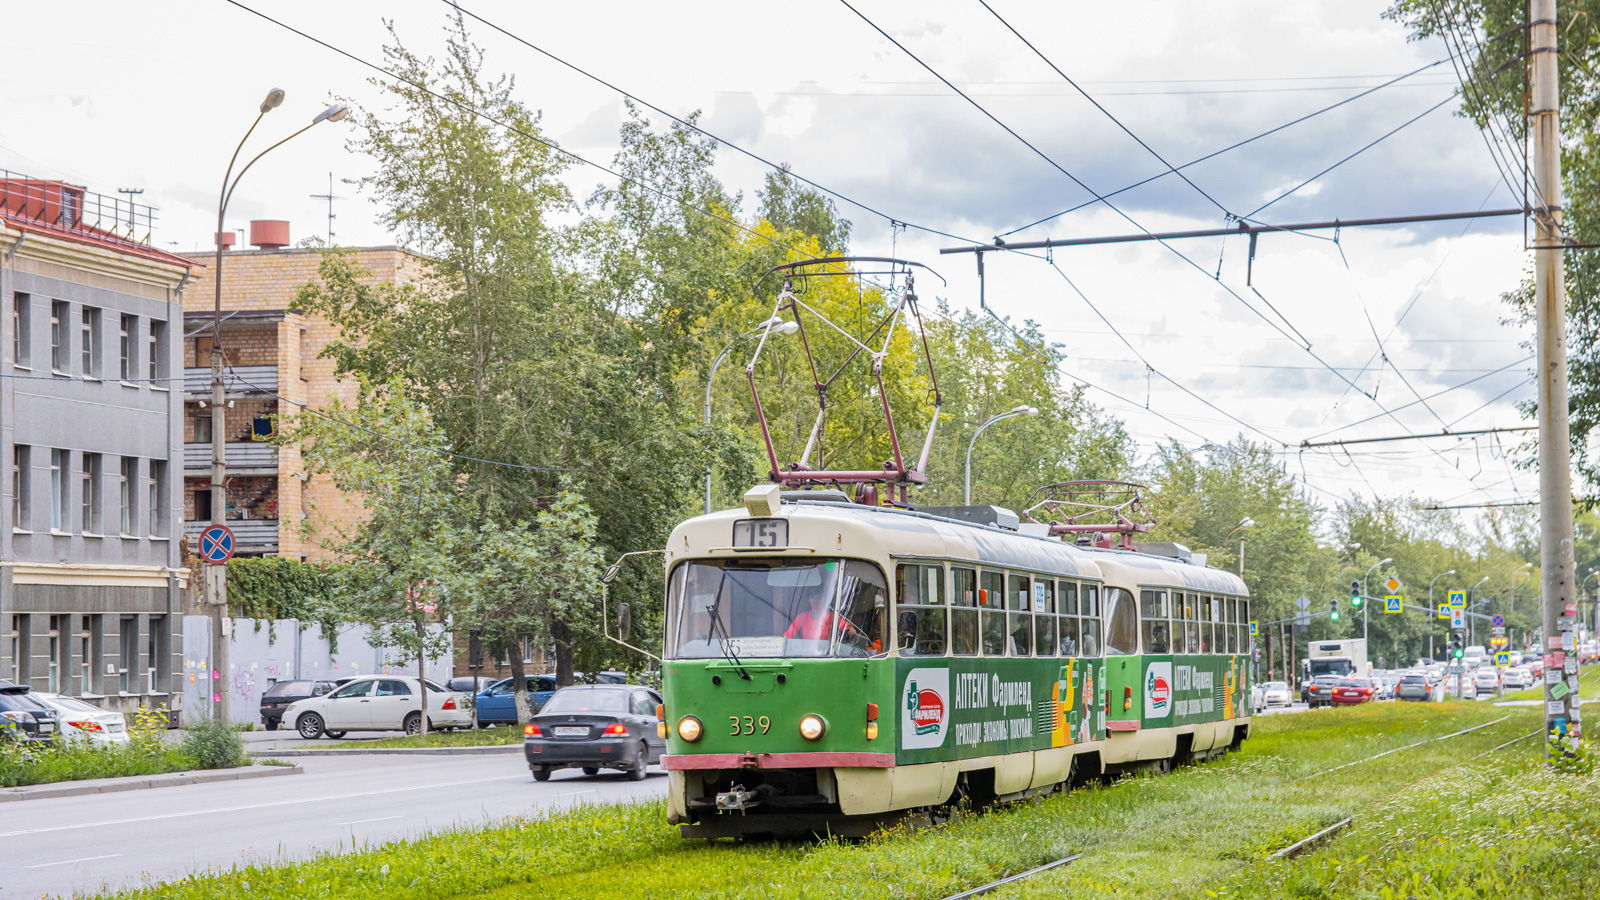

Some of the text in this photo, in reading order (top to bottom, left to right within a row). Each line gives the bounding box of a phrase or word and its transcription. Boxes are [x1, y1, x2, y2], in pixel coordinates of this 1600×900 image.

[745, 522, 777, 547] 15
[955, 672, 1032, 716] АПТЕКИ Фармленд
[729, 716, 772, 736] 339
